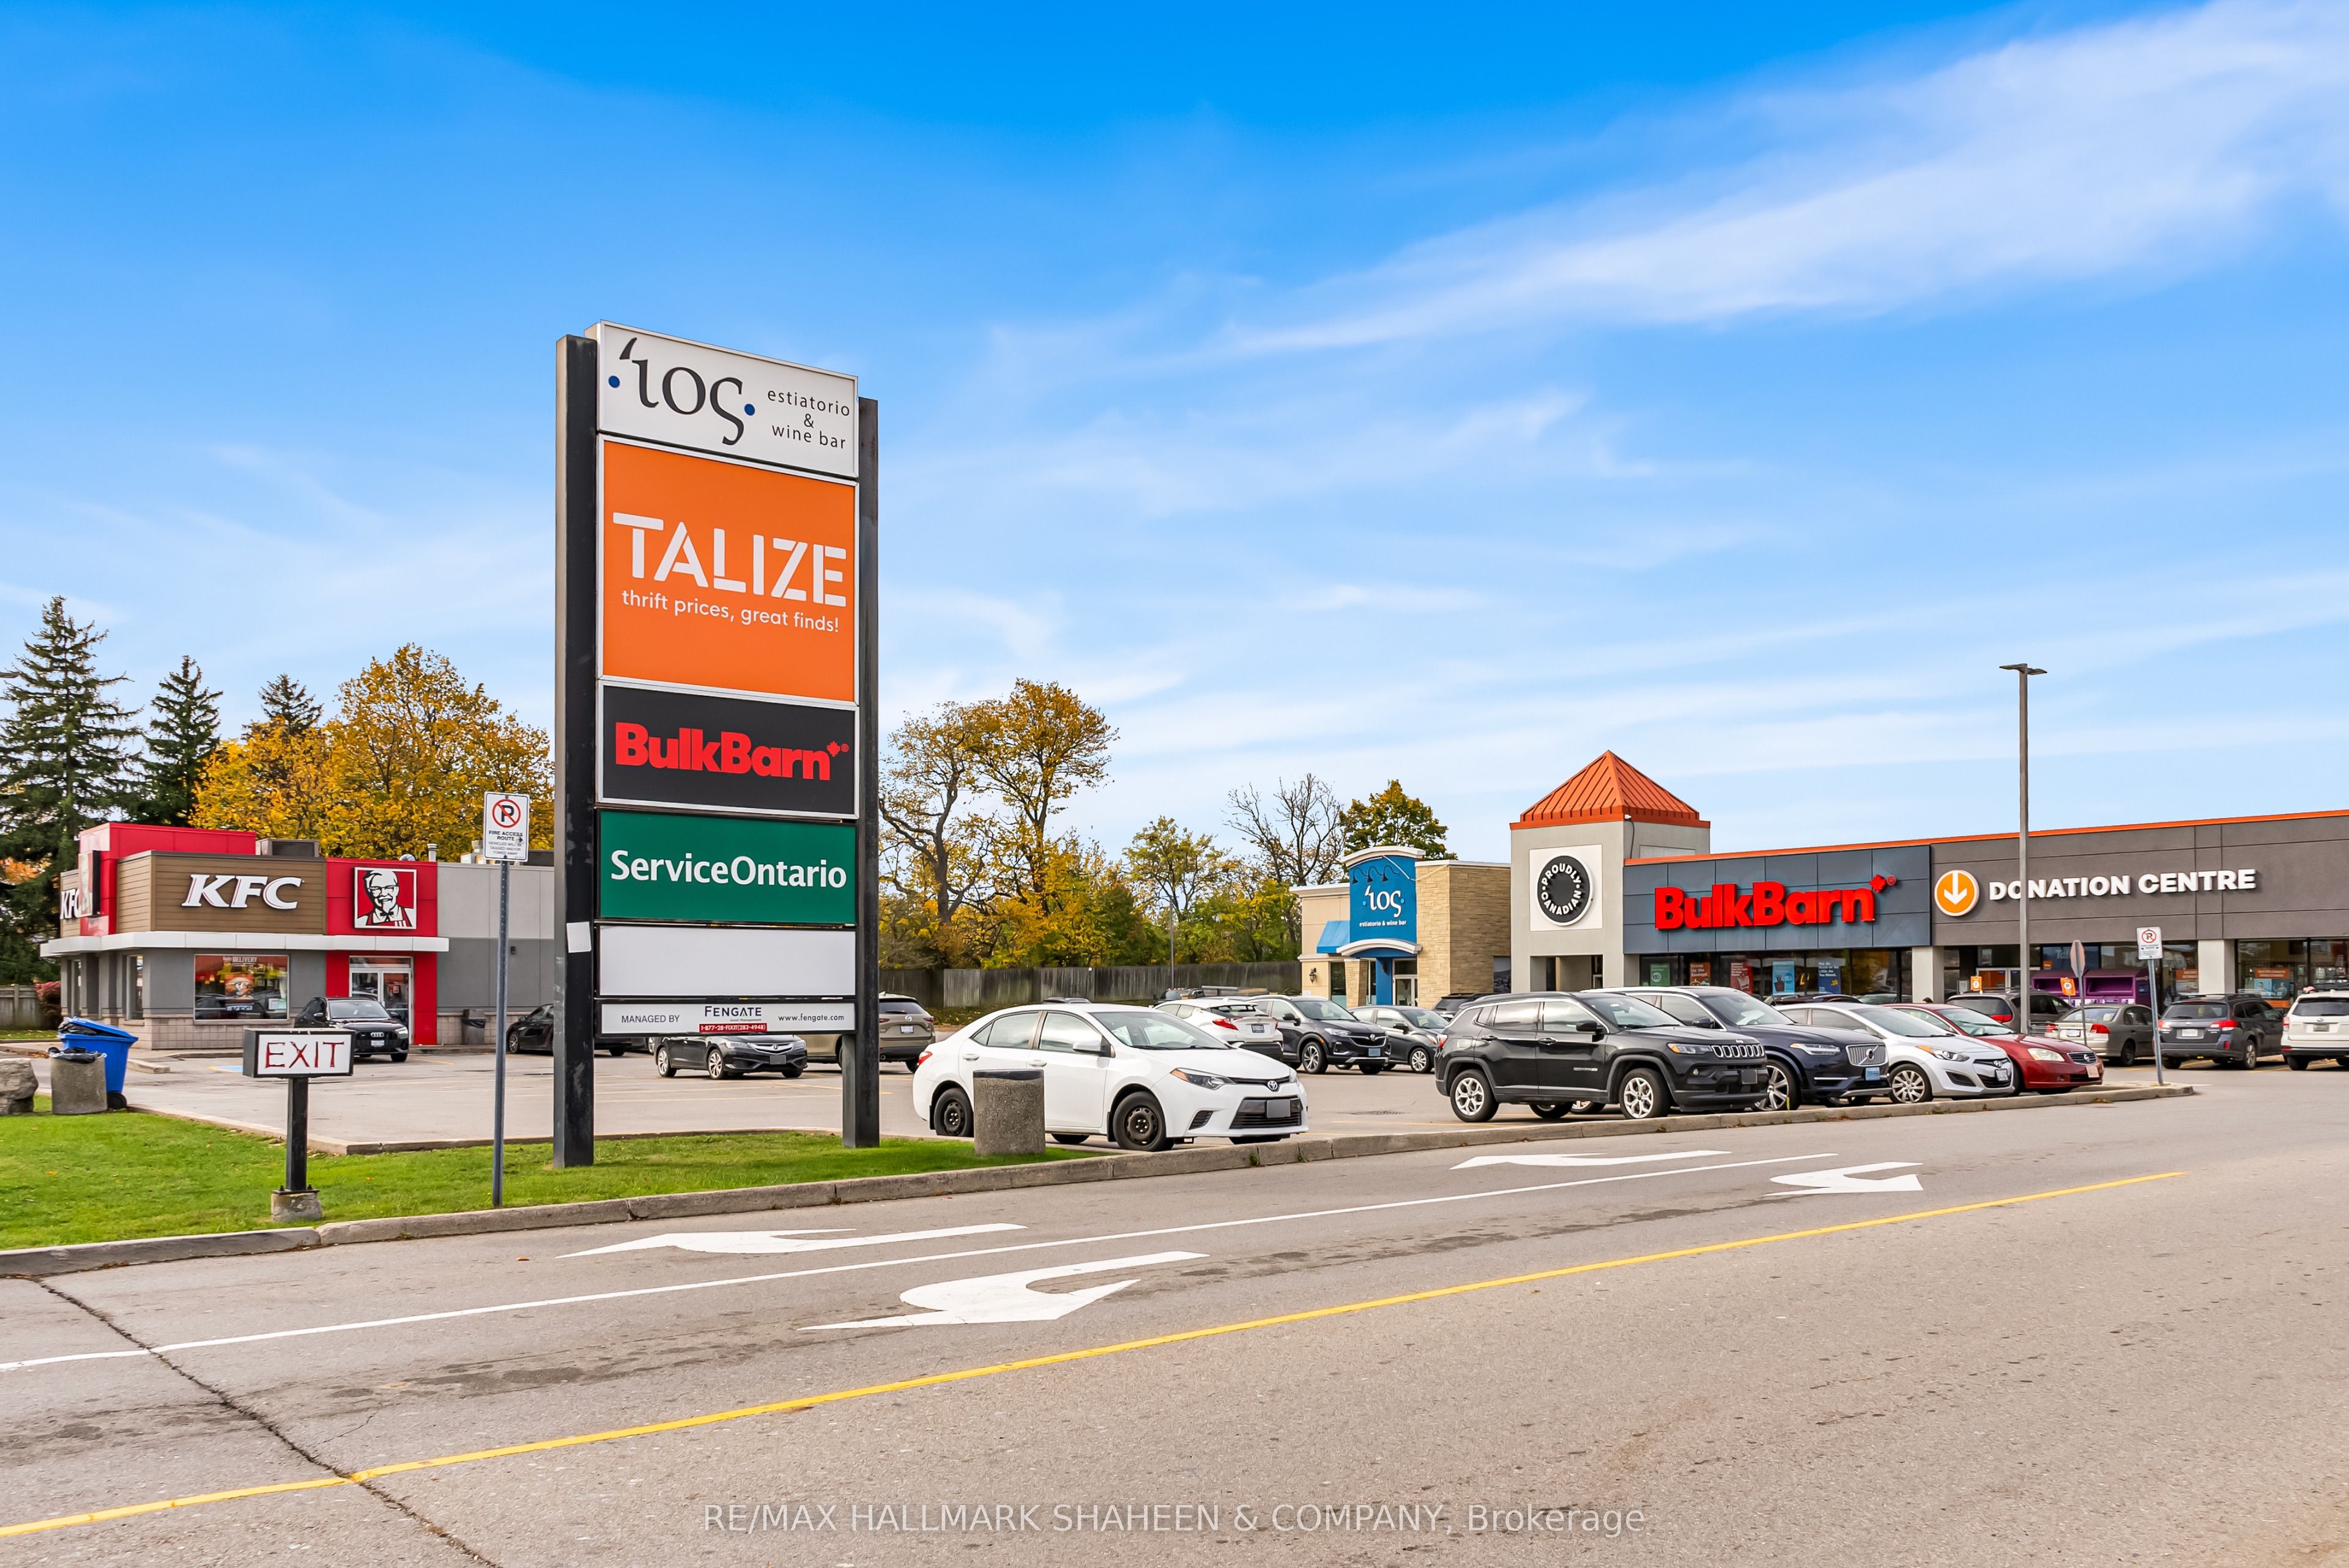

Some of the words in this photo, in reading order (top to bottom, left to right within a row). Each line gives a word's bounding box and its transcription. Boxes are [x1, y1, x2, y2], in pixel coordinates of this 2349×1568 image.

[767, 388, 850, 418] estiatorio
[803, 413, 815, 429] &
[771, 424, 812, 443] wine
[819, 434, 847, 449] bar
[612, 512, 847, 607] TALIZE
[622, 590, 668, 610] thrift
[674, 598, 735, 623] prices,
[740, 608, 789, 626] great
[793, 612, 839, 633] finds!
[615, 721, 831, 781] BulkBarn
[610, 849, 847, 889] ServiceOntario
[1541, 863, 1582, 886] PROUDLY
[180, 873, 303, 910] KFC
[1989, 875, 2131, 901] DONATION
[2137, 868, 2257, 894] CENTRE
[1541, 889, 1582, 915] CANADIAN
[1654, 880, 1876, 930] BulkBarn
[622, 1014, 667, 1024] MANAGED
[669, 1014, 680, 1023] BY
[704, 1005, 763, 1017] FENGATE
[777, 1012, 845, 1023] www.fengate.com
[265, 1040, 344, 1069] EXIT
